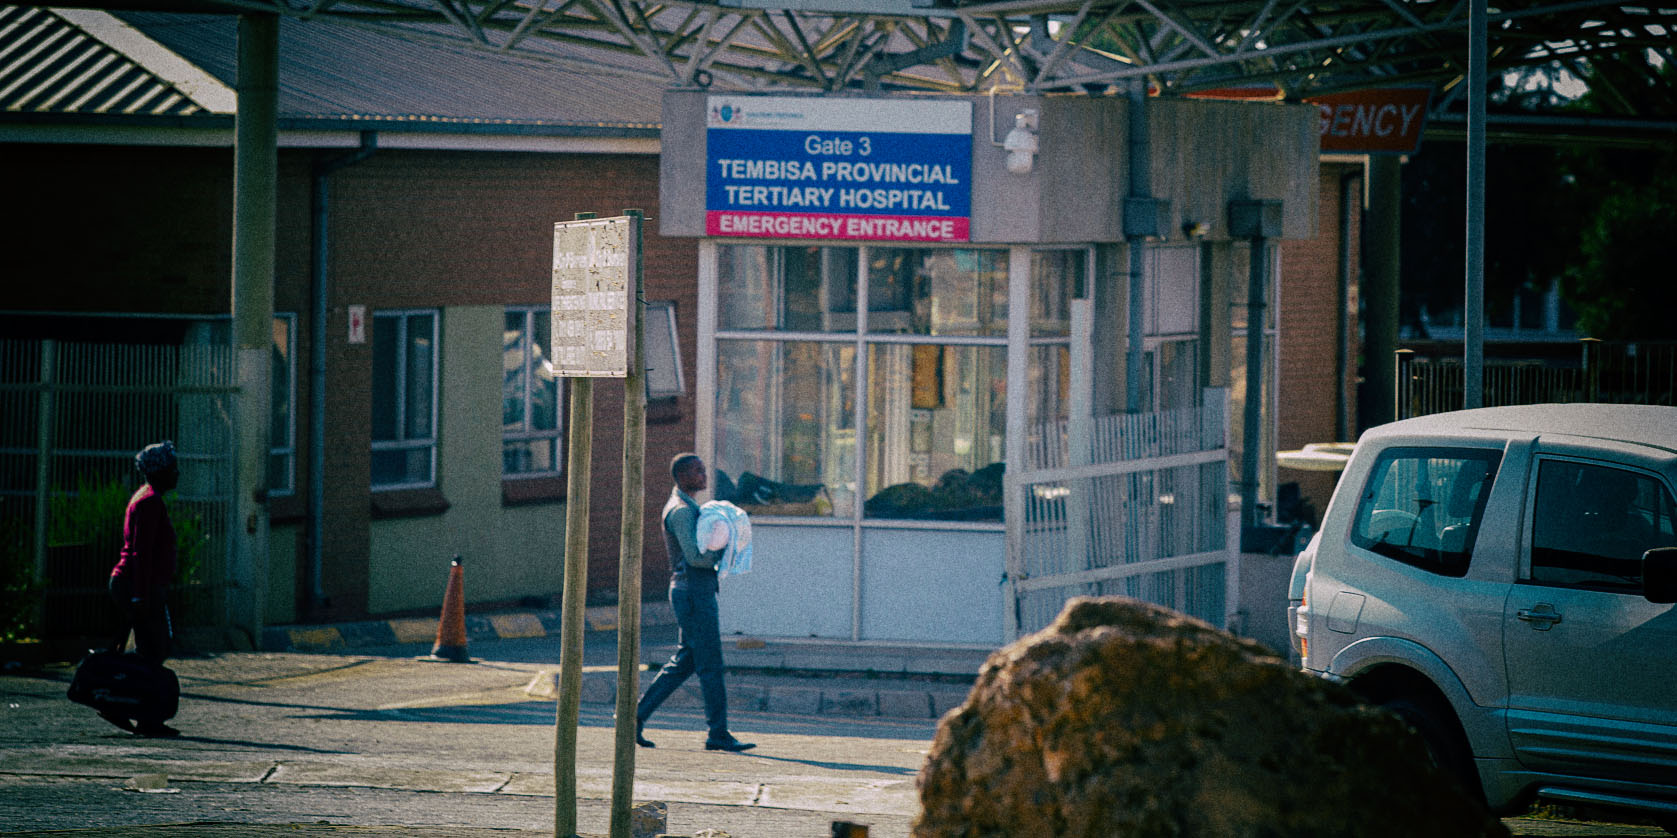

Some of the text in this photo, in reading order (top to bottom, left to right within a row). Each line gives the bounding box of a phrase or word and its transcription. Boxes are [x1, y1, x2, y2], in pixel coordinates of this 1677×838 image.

[805, 135, 872, 156] Gate 3
[718, 159, 959, 184] TEMBISA PROVINCIAL
[725, 186, 951, 210] TERTIARY HOSPITAL
[719, 215, 954, 238] EMERGENCY ENTRANCE
